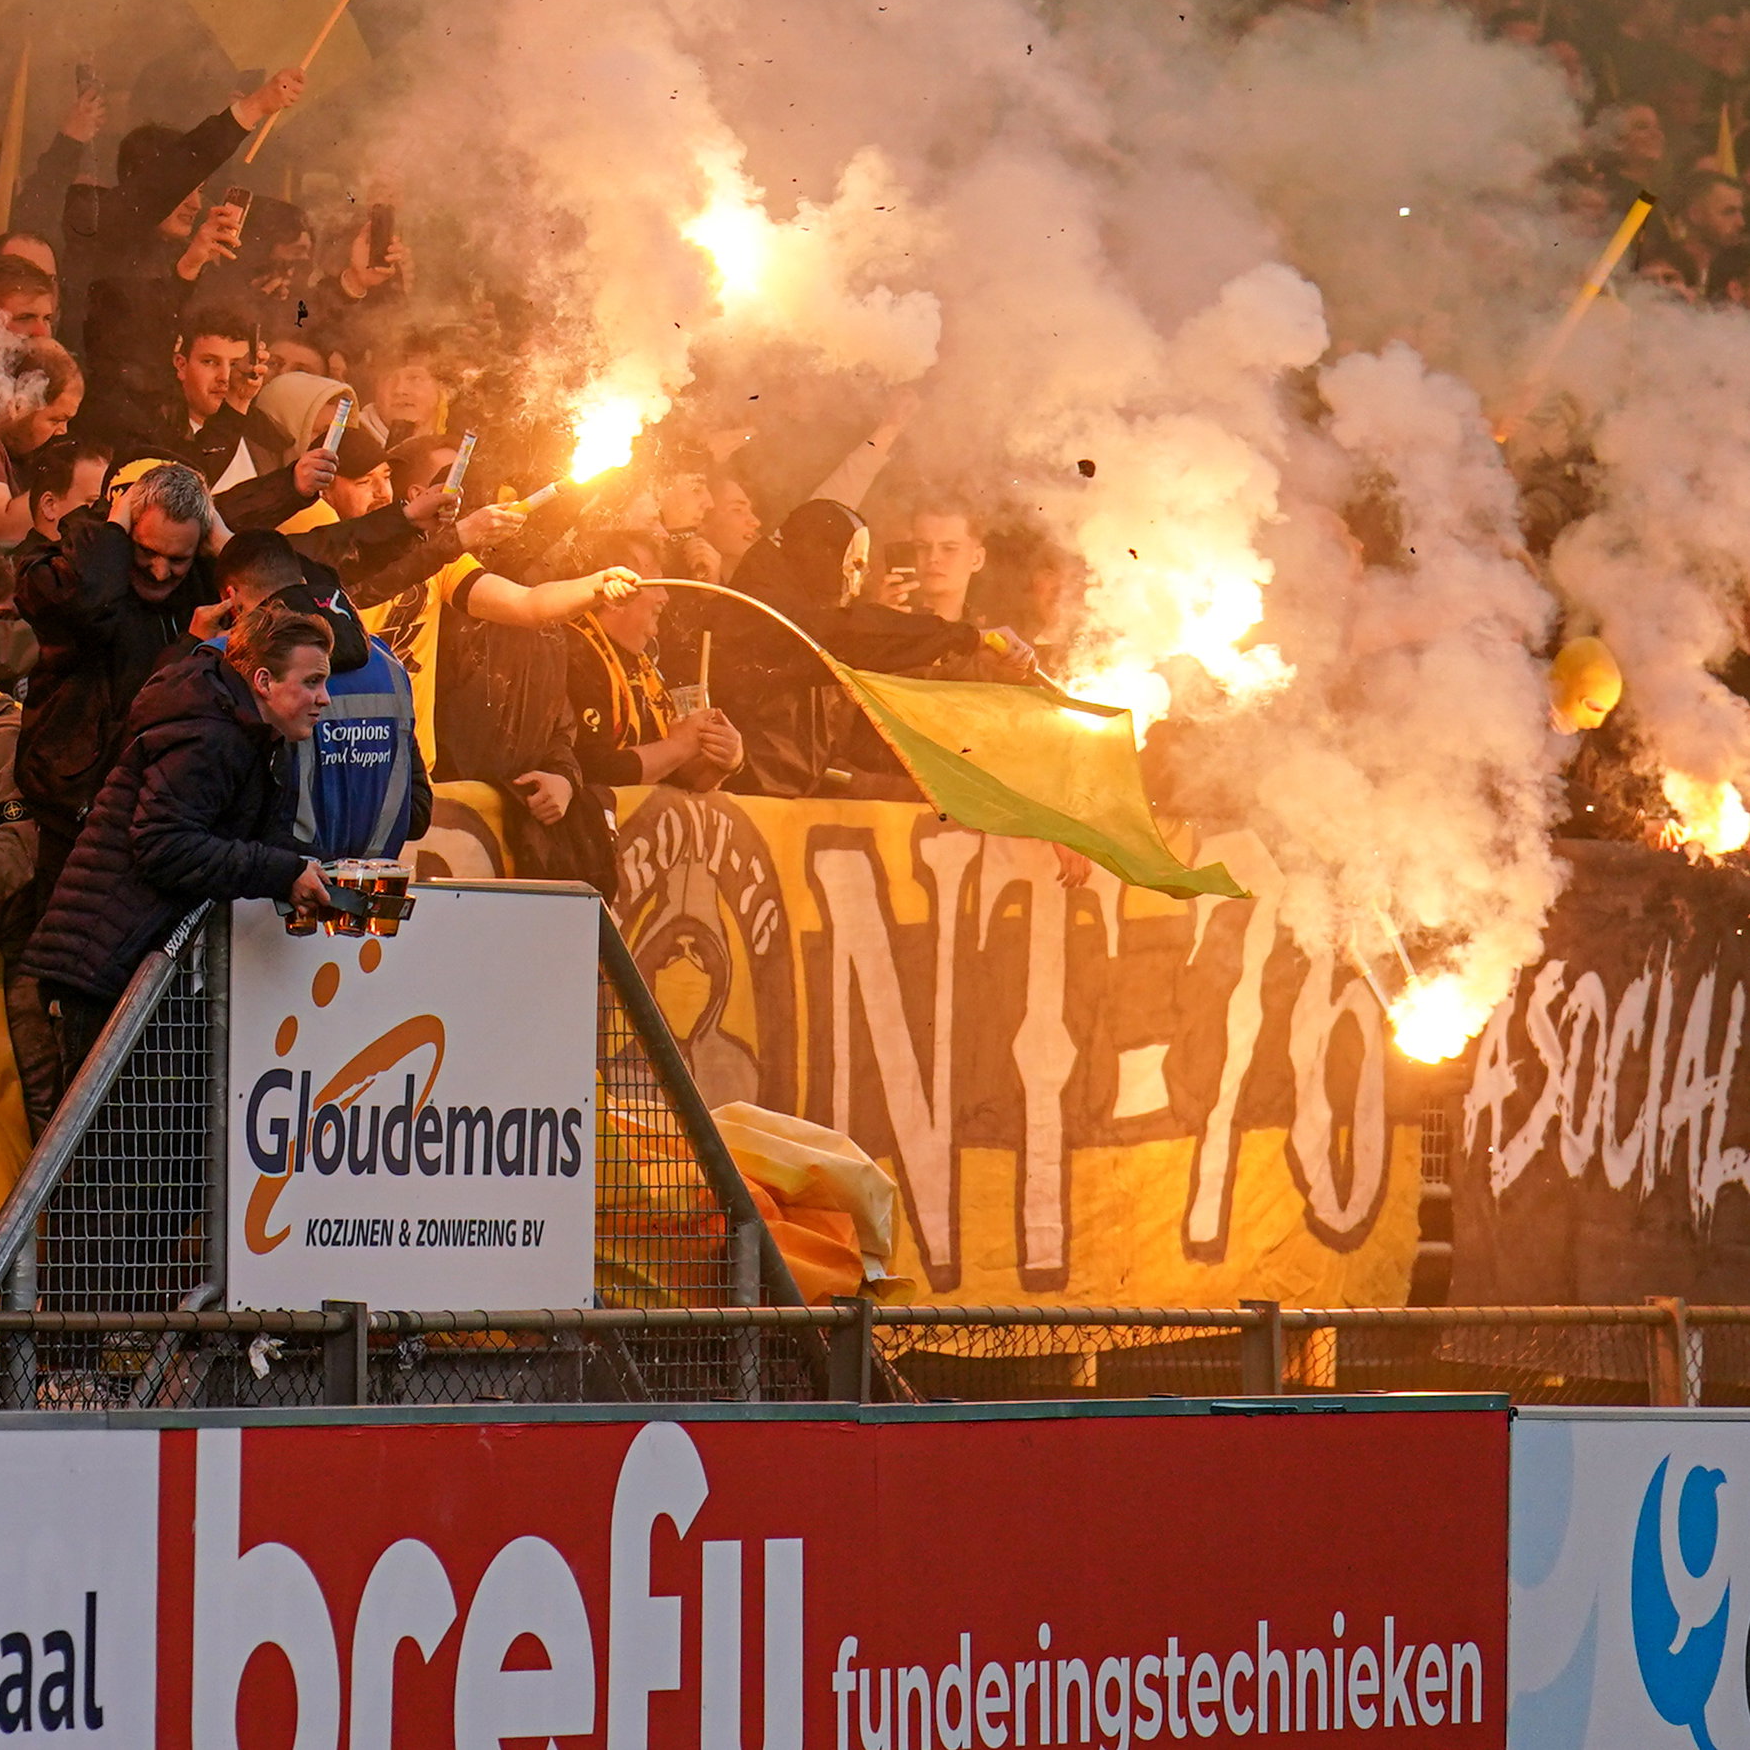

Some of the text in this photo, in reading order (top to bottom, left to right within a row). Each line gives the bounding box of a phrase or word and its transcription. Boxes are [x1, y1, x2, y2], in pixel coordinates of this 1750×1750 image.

[612, 798, 780, 956] RONT-76
[246, 1068, 582, 1178] Gloudemans
[305, 1218, 545, 1247] KOZIJNEN & ZONWERING BV
[192, 1421, 803, 1750] brefu
[832, 1611, 1484, 1750] funderingstechnieken
